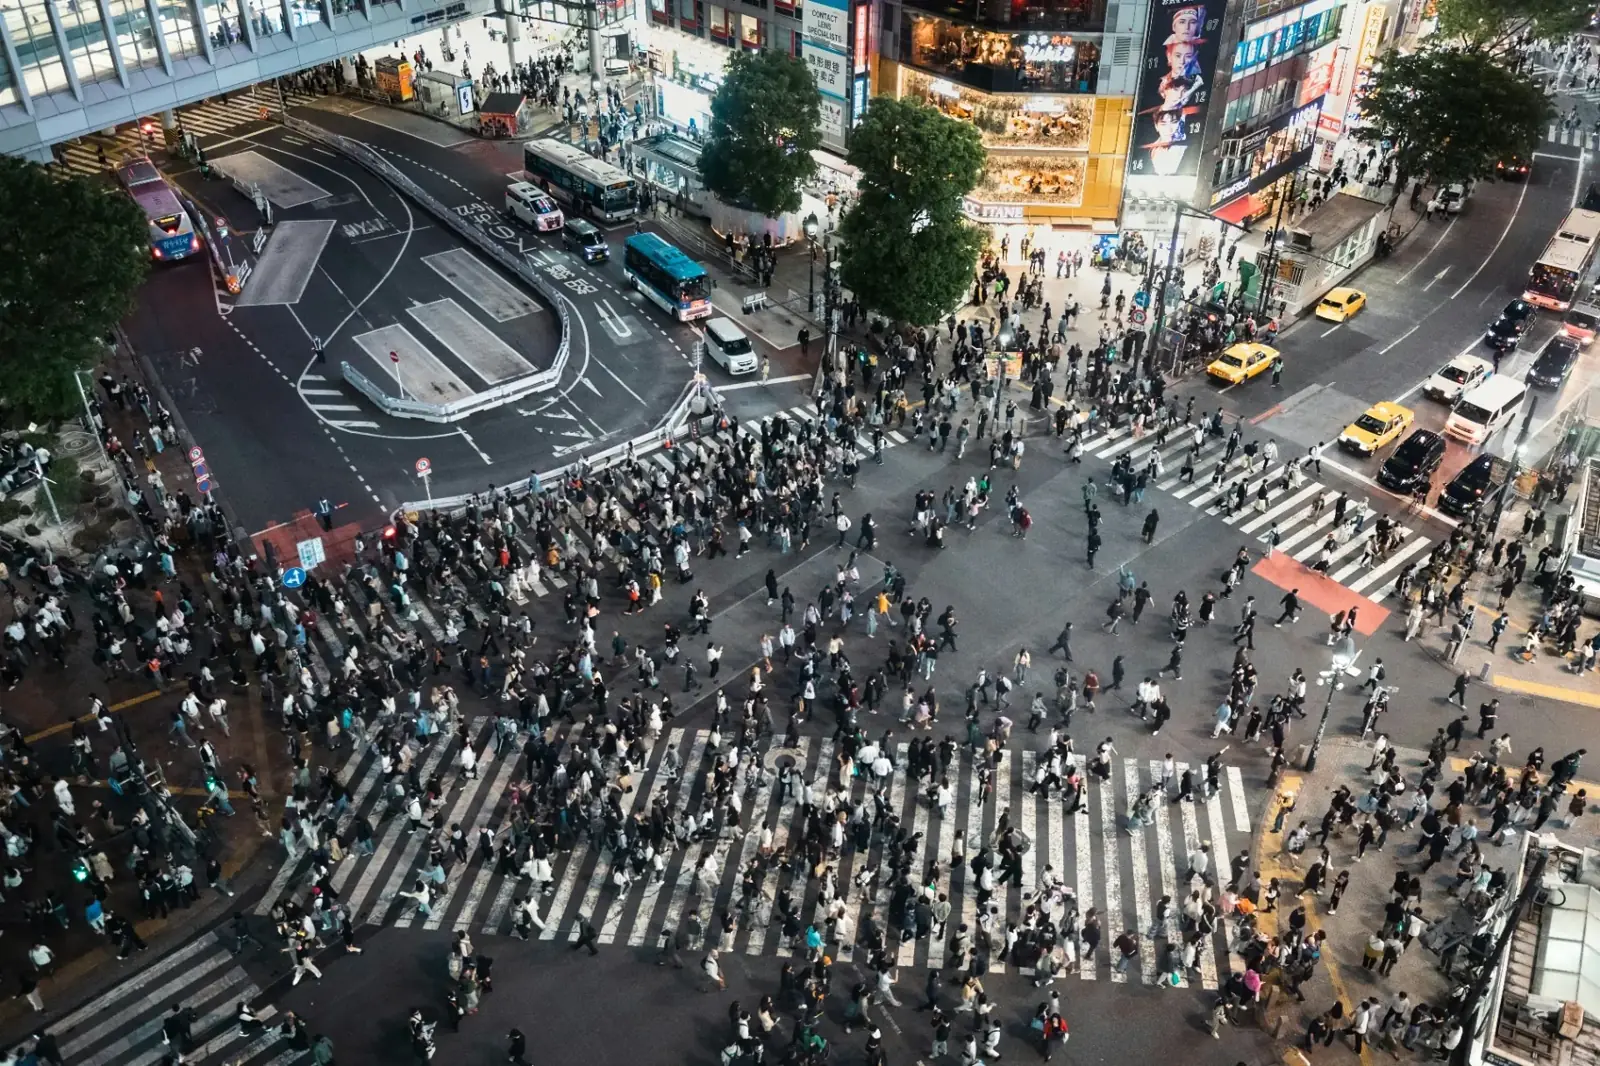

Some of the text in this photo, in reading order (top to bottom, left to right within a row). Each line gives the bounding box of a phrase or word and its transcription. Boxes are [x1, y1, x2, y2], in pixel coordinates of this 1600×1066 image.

[812, 9, 838, 23] CONTACT
[817, 19, 831, 30] LENS
[807, 26, 842, 43] SPECIALISTS
[808, 53, 840, 75] 隐形眼镜
[813, 68, 835, 85] 专卖店
